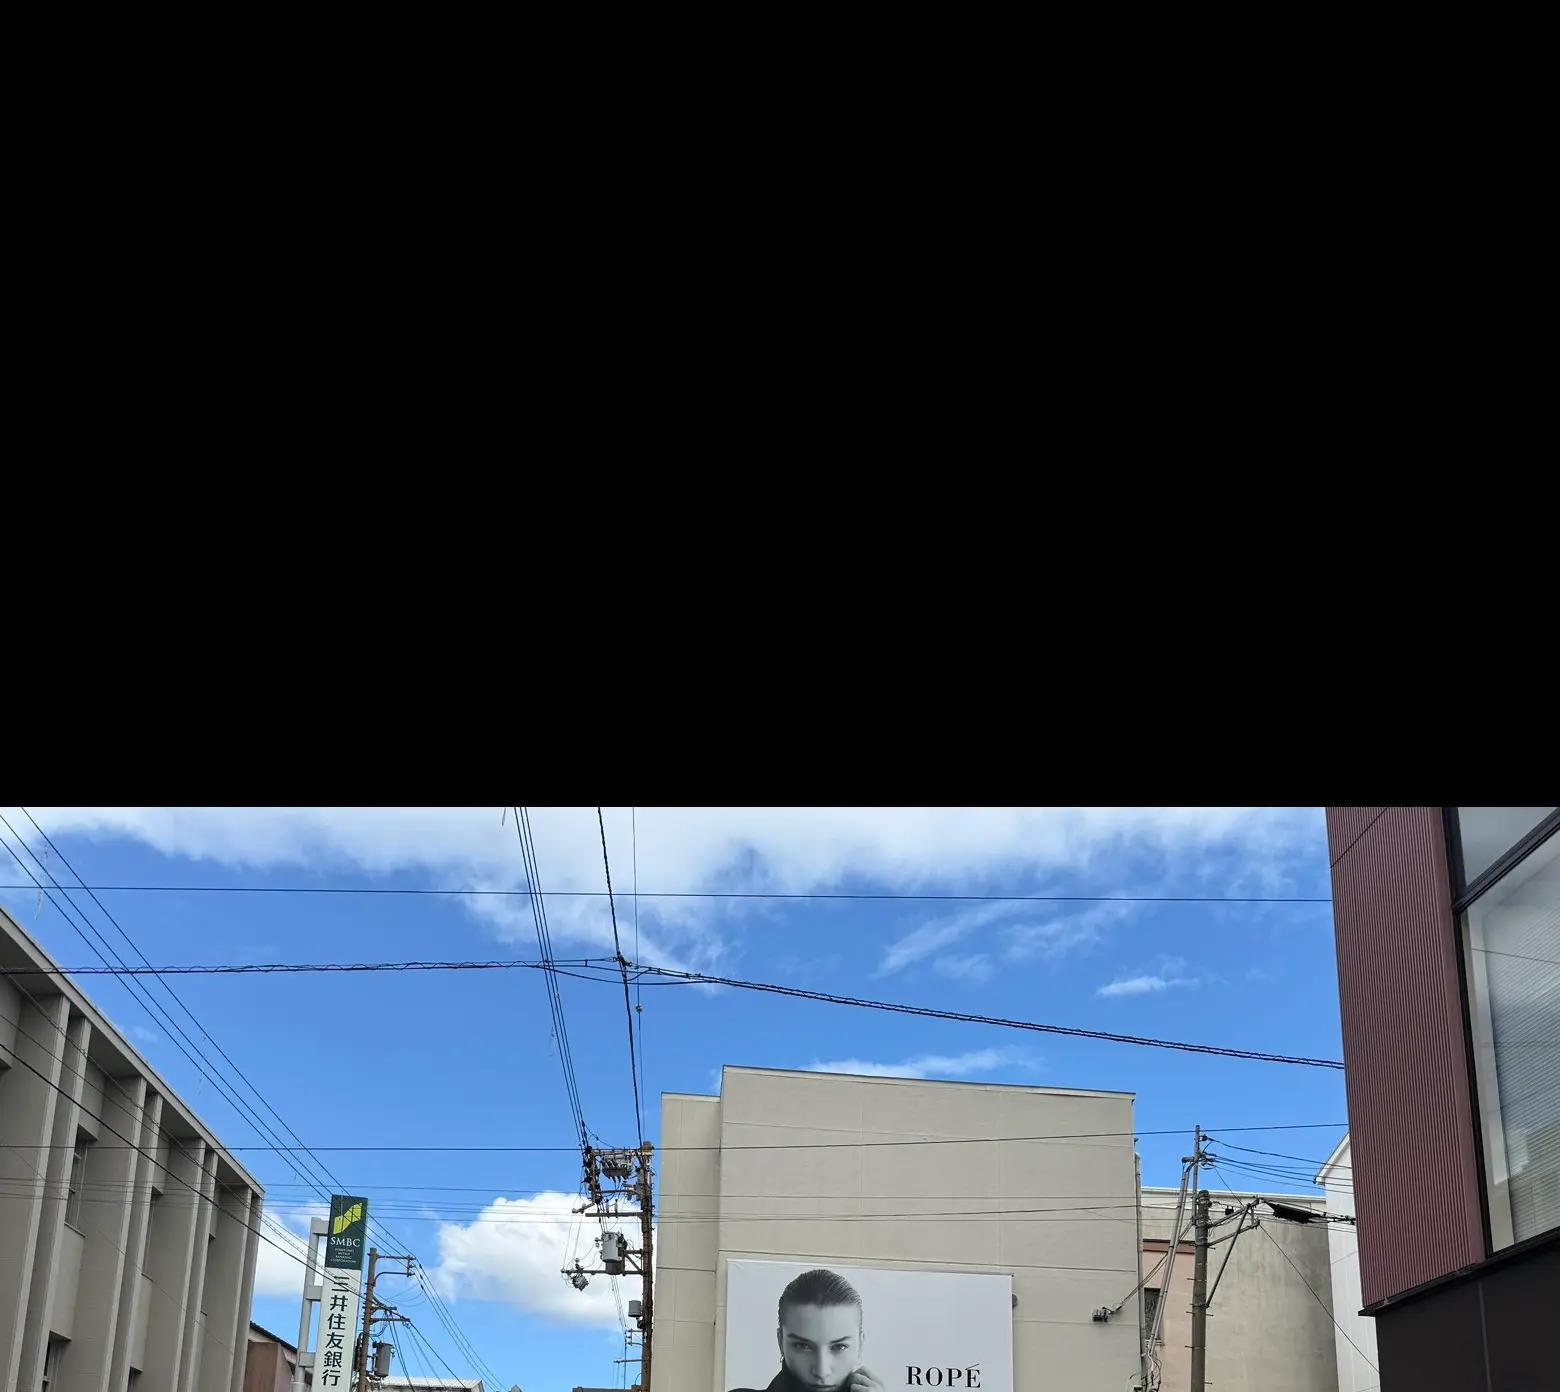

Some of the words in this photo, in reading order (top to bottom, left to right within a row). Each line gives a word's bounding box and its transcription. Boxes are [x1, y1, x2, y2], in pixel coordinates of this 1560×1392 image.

[330, 1236, 361, 1248] SMBC
[321, 1275, 350, 1387] 三井住友銀行
[905, 1363, 981, 1388] ROPÉ
